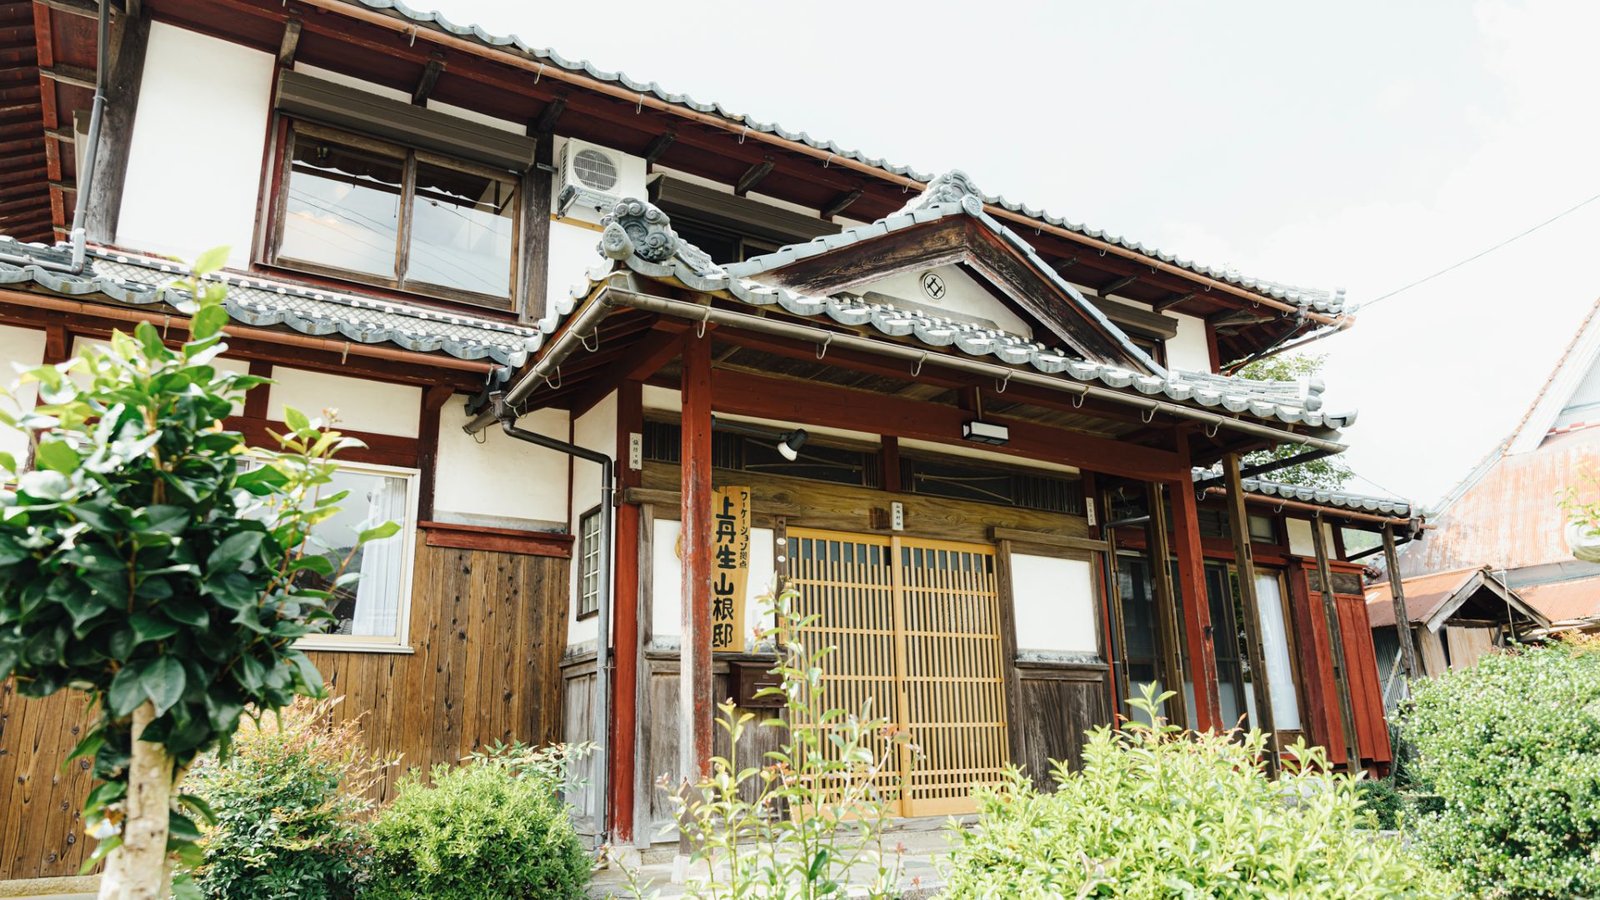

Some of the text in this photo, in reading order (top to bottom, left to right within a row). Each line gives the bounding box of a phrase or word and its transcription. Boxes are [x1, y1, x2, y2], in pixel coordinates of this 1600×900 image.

[712, 496, 737, 648] 上丹生山根邸
